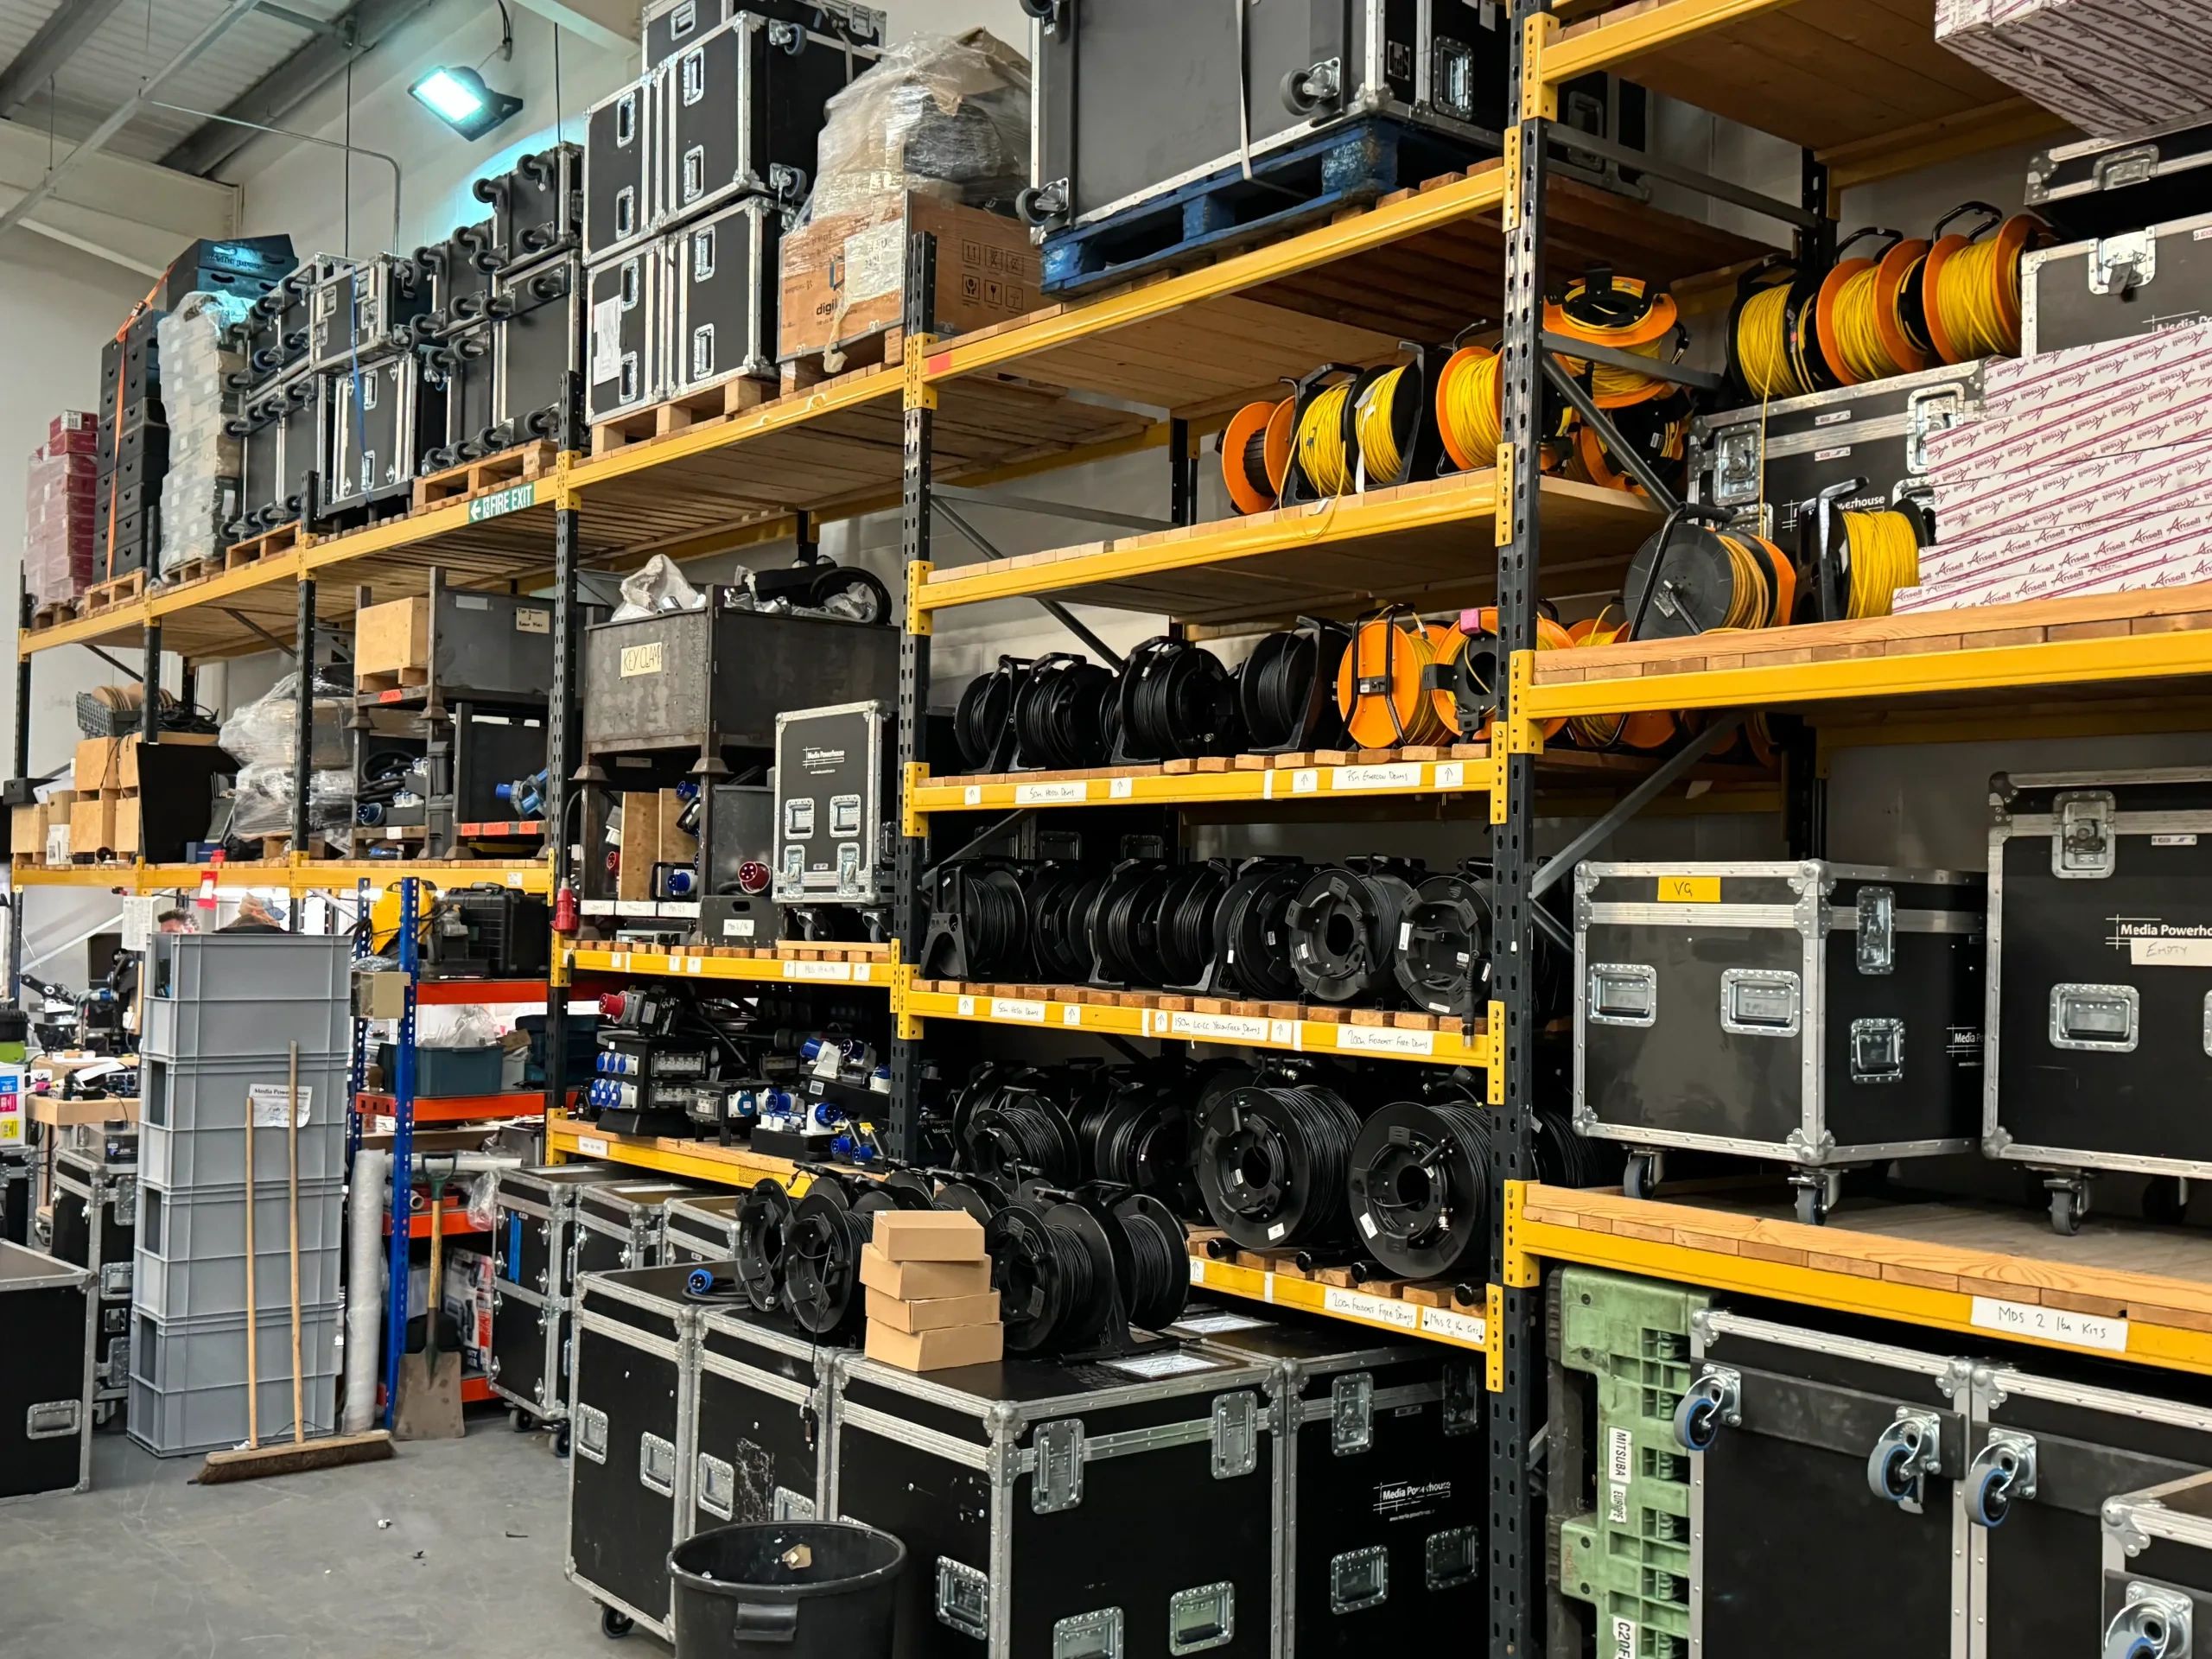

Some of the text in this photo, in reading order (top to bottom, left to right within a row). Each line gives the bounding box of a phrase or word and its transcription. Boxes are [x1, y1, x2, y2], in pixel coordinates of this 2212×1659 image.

[2172, 327, 2208, 346] Ansell
[2133, 342, 2167, 359] Ansell
[1998, 360, 2029, 377] Ansell
[2094, 355, 2129, 373] Ansell
[2058, 370, 2091, 387] Ansell
[2159, 365, 2195, 384] Ansell
[2021, 384, 2053, 399] Ansell
[2148, 384, 2181, 403] Ansell
[2112, 397, 2144, 416] Ansell
[1984, 416, 2013, 434] Ansell
[2075, 411, 2107, 430] Ansell
[2174, 406, 2208, 427] Ansell
[1952, 430, 1980, 448] Ansell
[2042, 425, 2072, 443] Ansell
[2137, 422, 2170, 440] Ansell
[2008, 439, 2037, 456] Ansell
[2101, 435, 2132, 453] Ansell
[1975, 452, 2004, 470] Ansell
[2078, 460, 2110, 477] Ansell
[2177, 456, 2211, 475] Ansell
[2043, 474, 2074, 490] Ansell
[2139, 471, 2172, 489] Ansell
[491, 485, 532, 515] FIRE EXIT
[2009, 486, 2038, 503] Ansell
[2103, 484, 2135, 501] Ansell
[1975, 498, 2005, 515] Ansell
[2068, 497, 2098, 514] Ansell
[2033, 508, 2063, 525] Ansell
[2058, 552, 2089, 569] Ansell
[2094, 541, 2126, 557] Ansell
[2130, 529, 2162, 546] Ansell
[2167, 517, 2200, 534] Ansell
[1936, 562, 1963, 577] Ansell
[1968, 550, 1997, 567] Ansell
[2001, 539, 2031, 555] Ansell
[1980, 591, 2011, 606] Ansell
[2015, 581, 2046, 596] Ansell
[2051, 570, 2084, 588] Ansell
[2152, 572, 2186, 589] Ansell
[2120, 924, 2158, 936] Media
[1955, 1032, 1975, 1044] Media
[1999, 1306, 2024, 1324] MDS
[2036, 1313, 2046, 1328] 2
[2082, 1322, 2107, 1339] KITS
[1615, 1431, 1626, 1476] MITSUBA
[1382, 1488, 1406, 1500] Media
